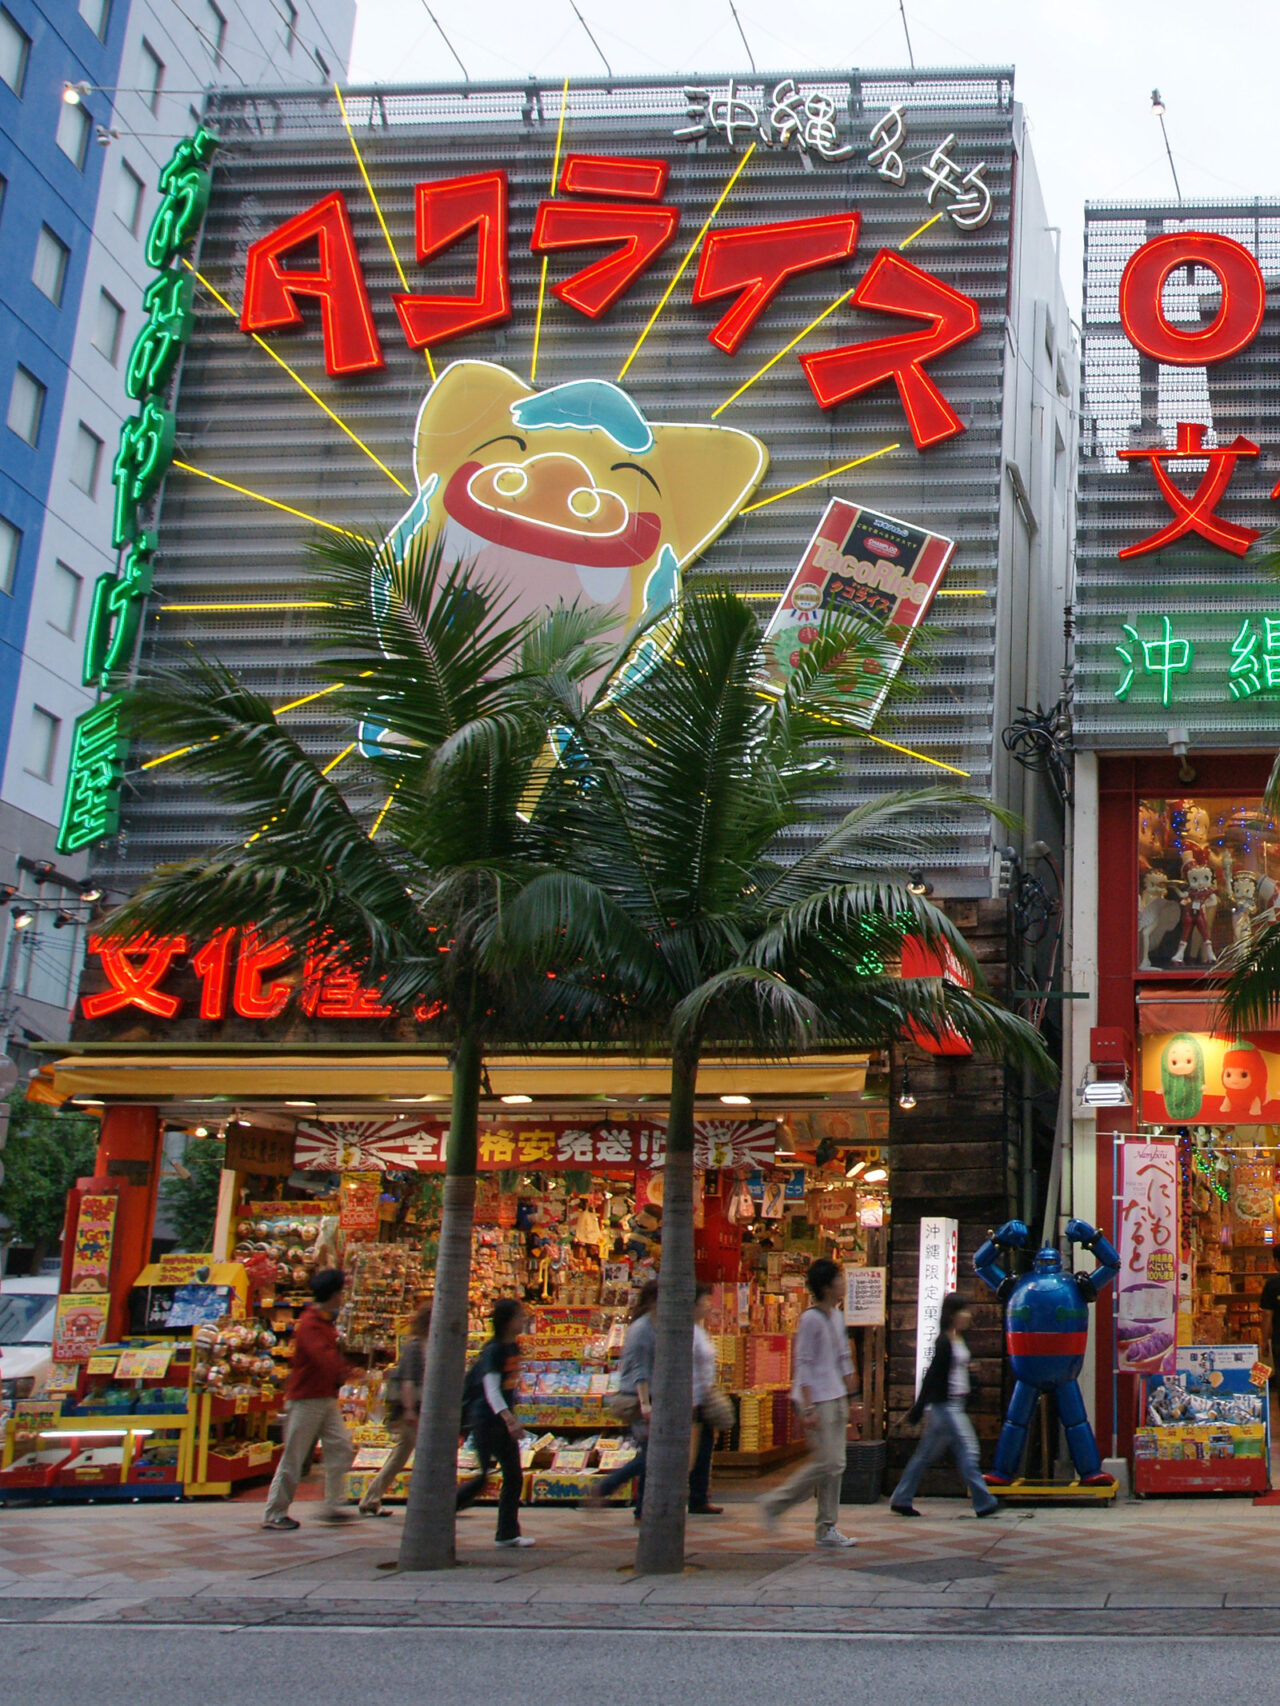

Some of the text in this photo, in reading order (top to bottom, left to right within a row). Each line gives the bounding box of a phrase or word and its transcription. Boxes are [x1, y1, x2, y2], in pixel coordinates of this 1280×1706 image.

[672, 78, 992, 231] 沖縄名物
[240, 153, 982, 453] タコライス
[811, 536, 930, 605] TacoRice
[829, 580, 890, 613] タコライス
[401, 1128, 662, 1163] 全格安発送!!
[1136, 1160, 1175, 1247] べにいも
